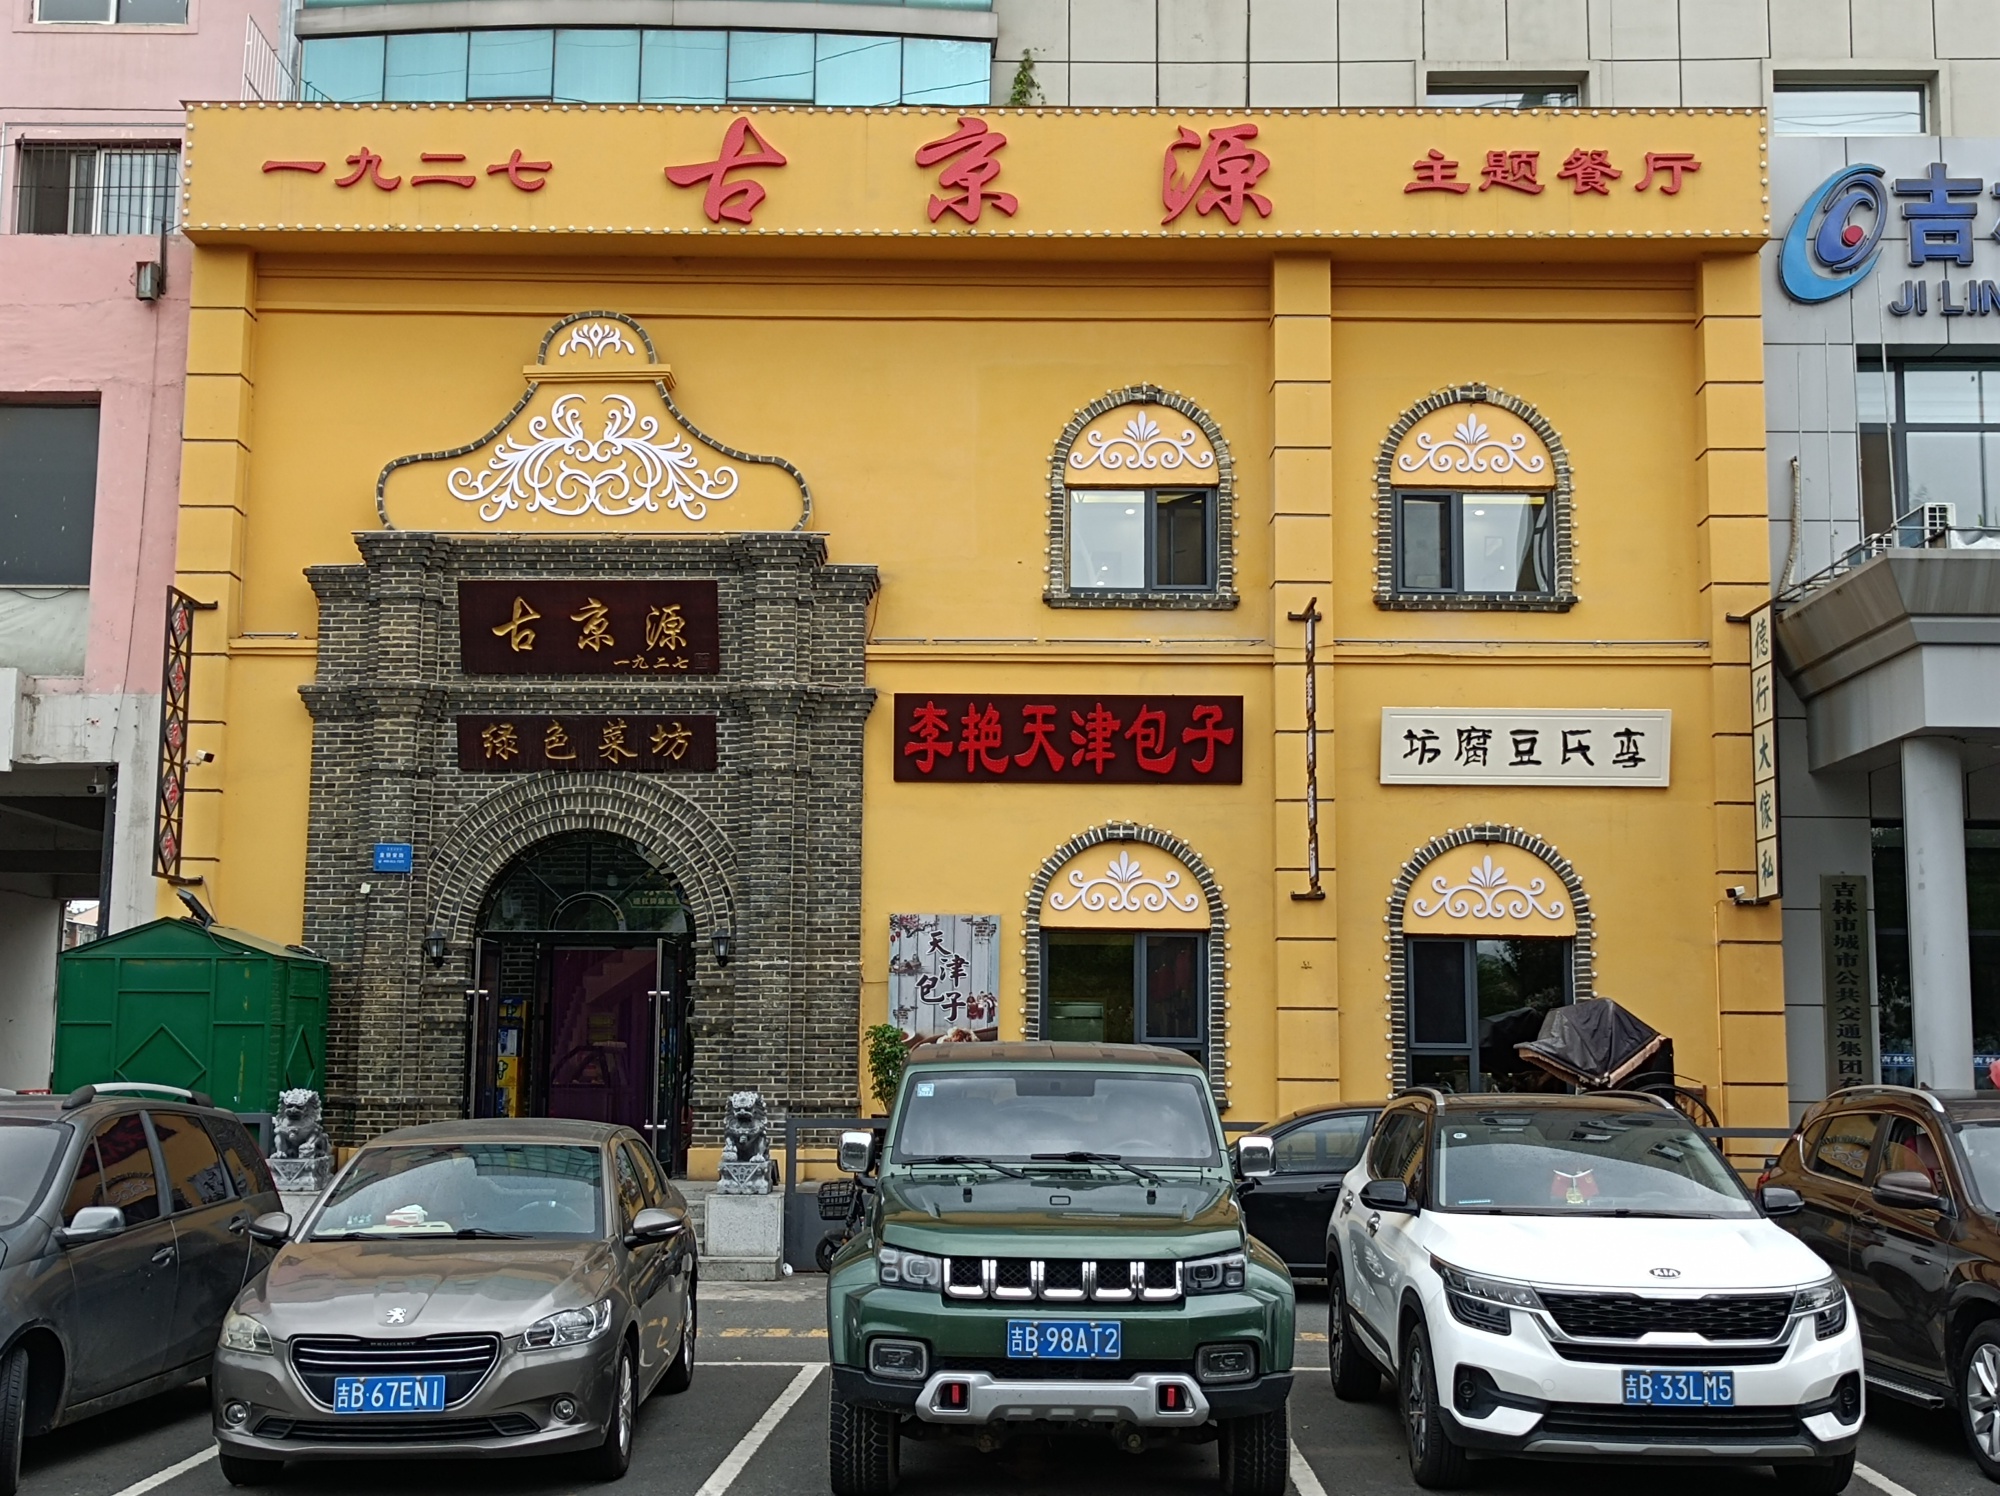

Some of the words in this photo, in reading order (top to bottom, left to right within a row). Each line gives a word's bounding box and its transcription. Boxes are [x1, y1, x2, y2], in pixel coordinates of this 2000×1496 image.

[262, 146, 553, 192] 一九二七
[664, 116, 1272, 225] 古京源
[1404, 148, 1702, 194] 主题餐厅
[1892, 162, 2000, 267] 吉
[1888, 279, 1928, 316] JI
[491, 595, 688, 652] 古京源
[613, 653, 690, 670] 一九二七
[481, 718, 692, 764] 绿色菜坊
[904, 700, 1235, 775] 李艳天津包子
[1653, 1268, 1678, 1277] KIA
